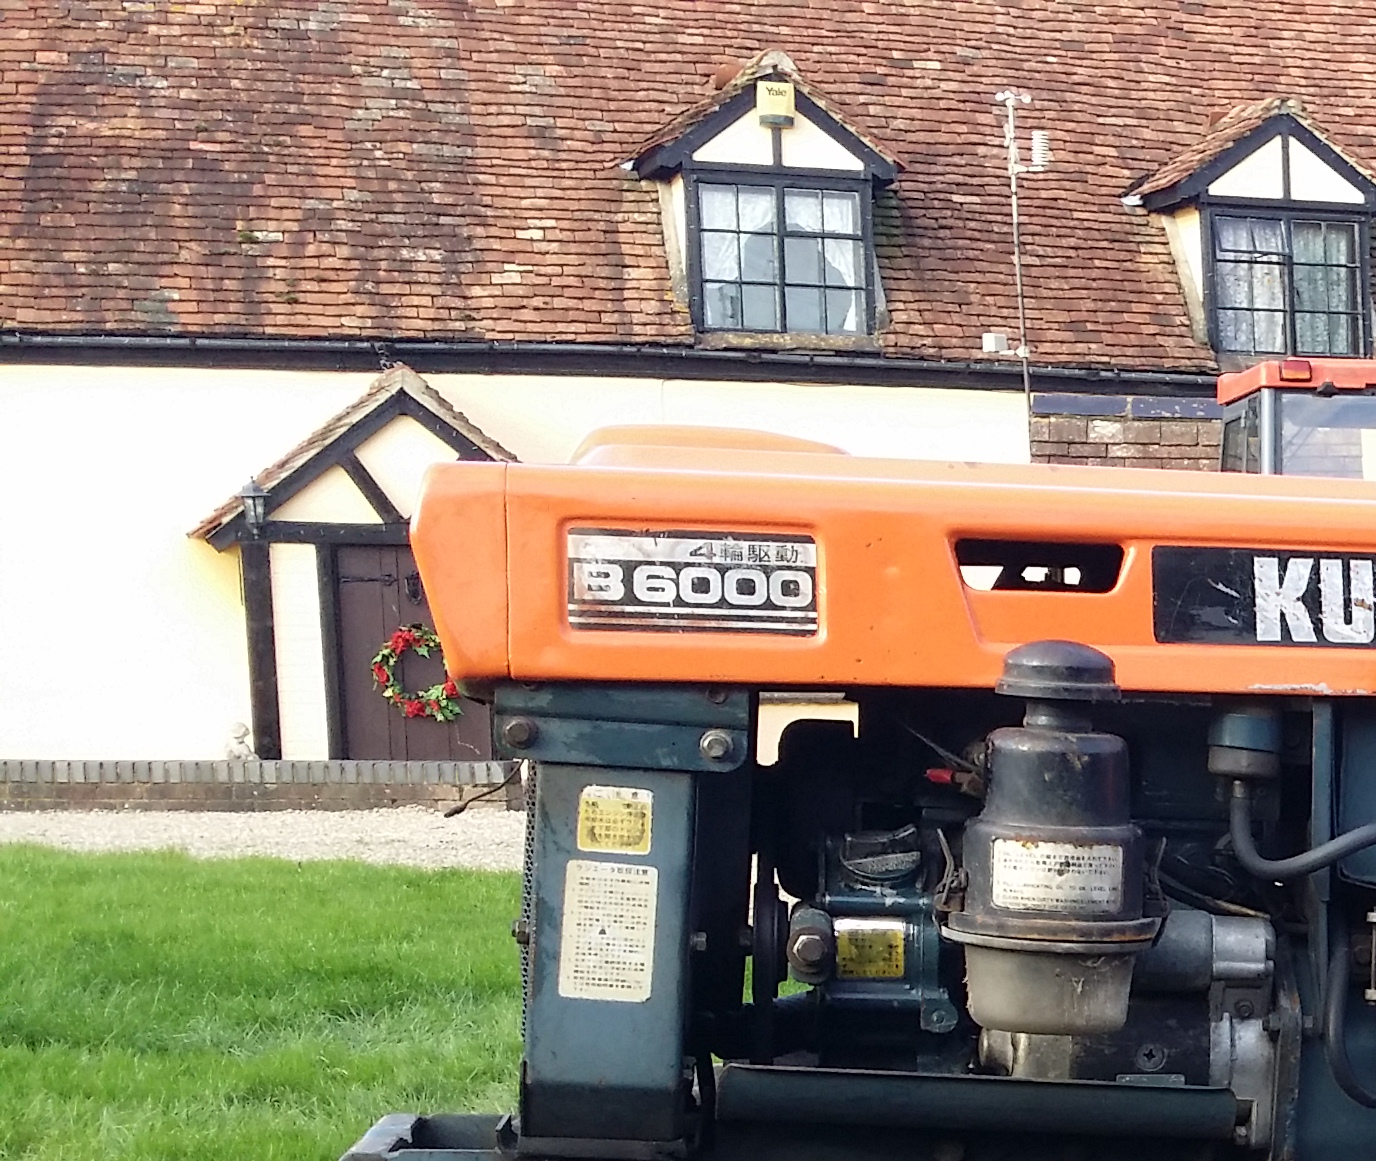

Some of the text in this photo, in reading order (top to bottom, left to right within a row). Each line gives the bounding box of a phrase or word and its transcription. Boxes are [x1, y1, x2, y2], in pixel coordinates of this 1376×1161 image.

[766, 86, 787, 97] Yale
[689, 541, 801, 564] 4輪駆動
